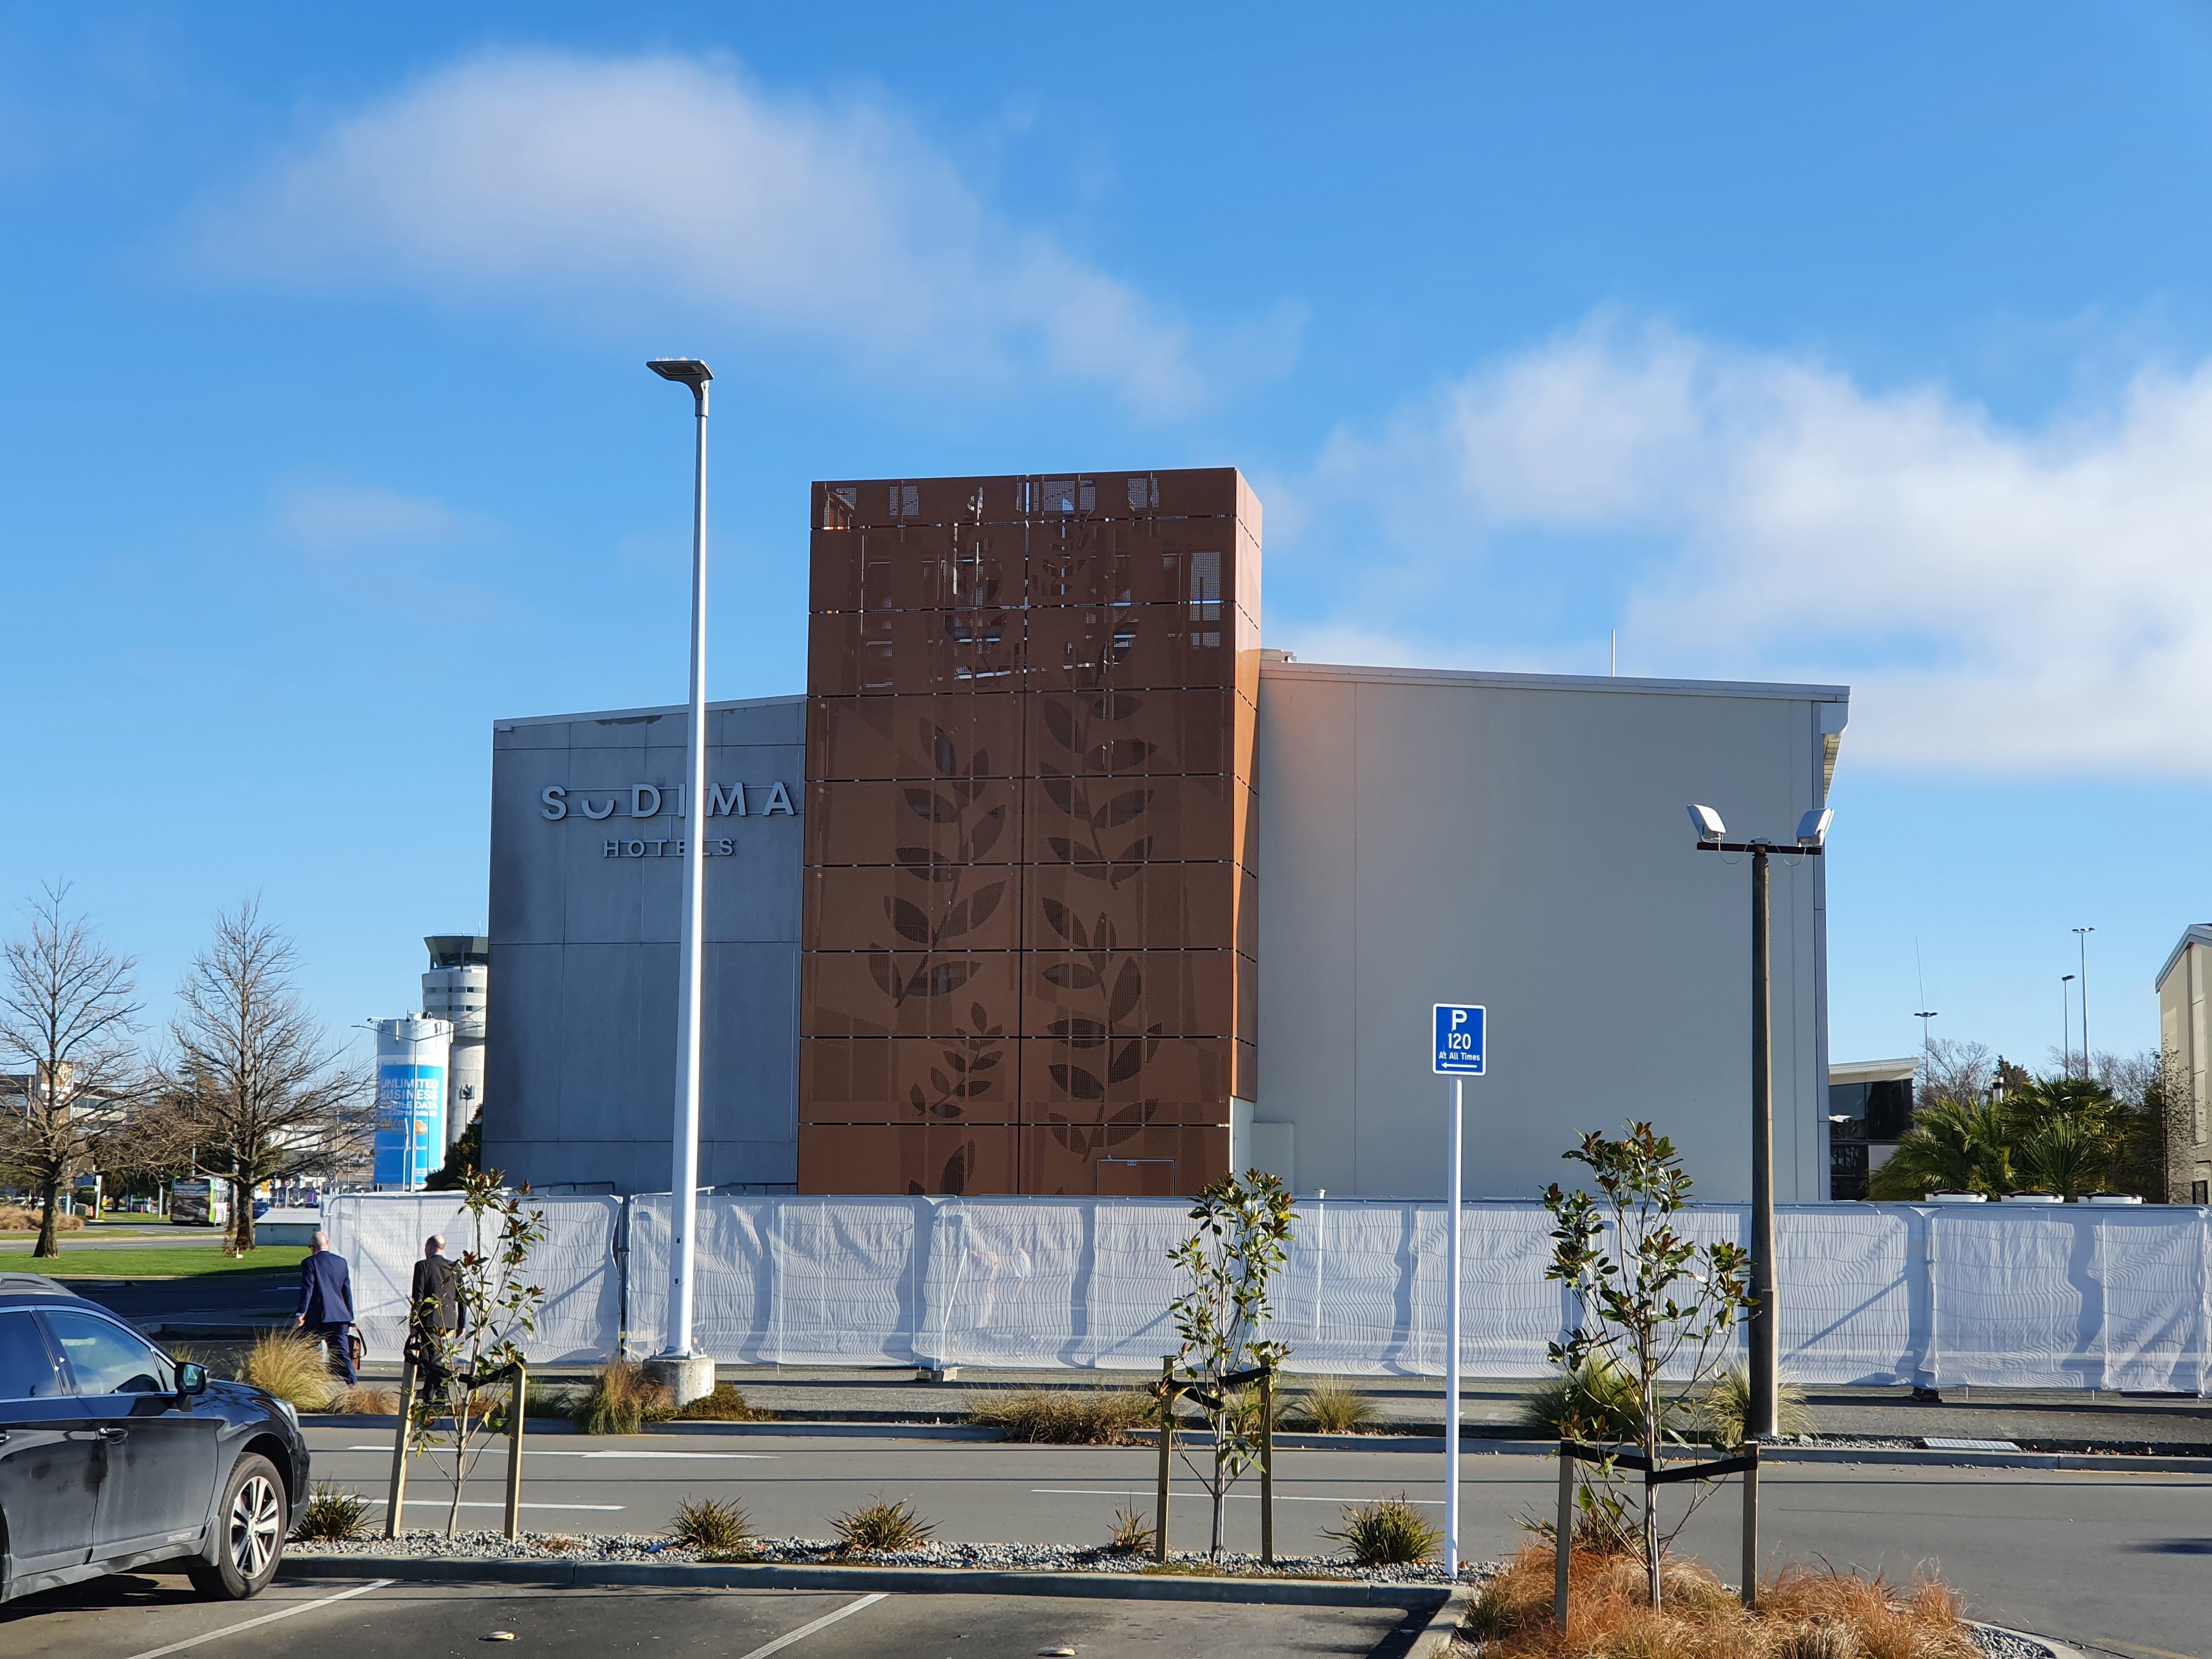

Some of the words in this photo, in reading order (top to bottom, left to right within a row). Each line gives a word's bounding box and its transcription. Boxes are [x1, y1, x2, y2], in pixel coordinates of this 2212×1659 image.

[603, 837, 733, 857] HOTES
[1452, 1009, 1468, 1031] P
[1448, 1033, 1471, 1050] 120
[1438, 1051, 1447, 1059] At
[1449, 1052, 1459, 1060] All
[1460, 1052, 1480, 1061] Times
[416, 1101, 438, 1109] DATA
